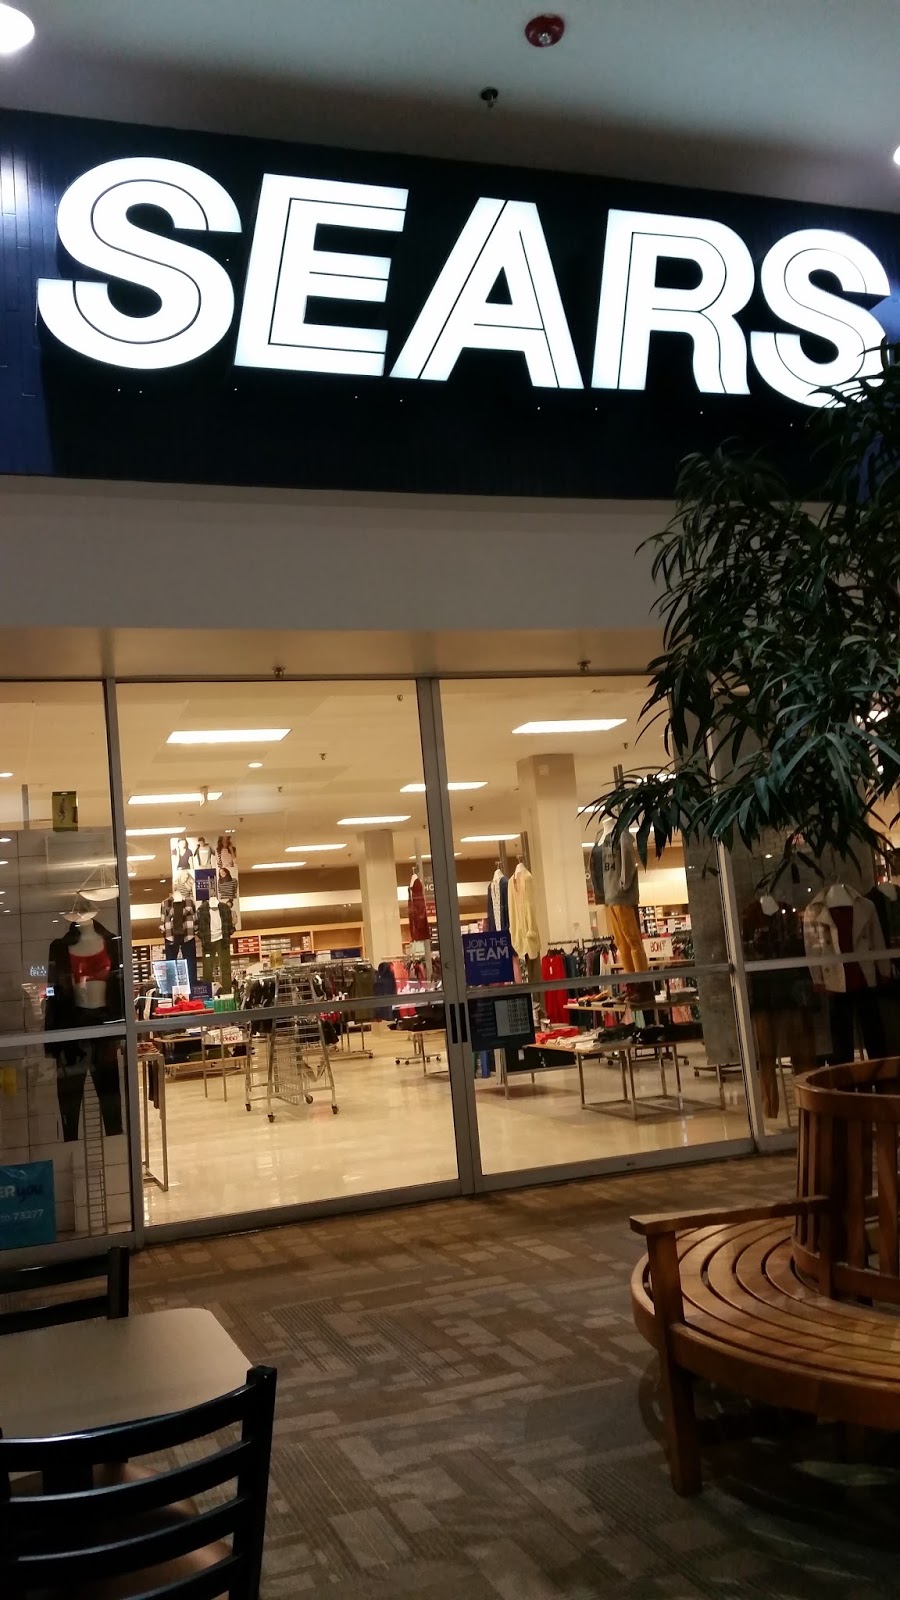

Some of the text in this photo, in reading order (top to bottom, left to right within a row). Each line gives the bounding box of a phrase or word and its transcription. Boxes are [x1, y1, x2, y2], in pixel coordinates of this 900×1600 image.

[37, 156, 891, 409] SEARS
[467, 936, 508, 949] JOIN THE
[466, 945, 510, 962] TEAM
[12, 1208, 44, 1221] 73277
